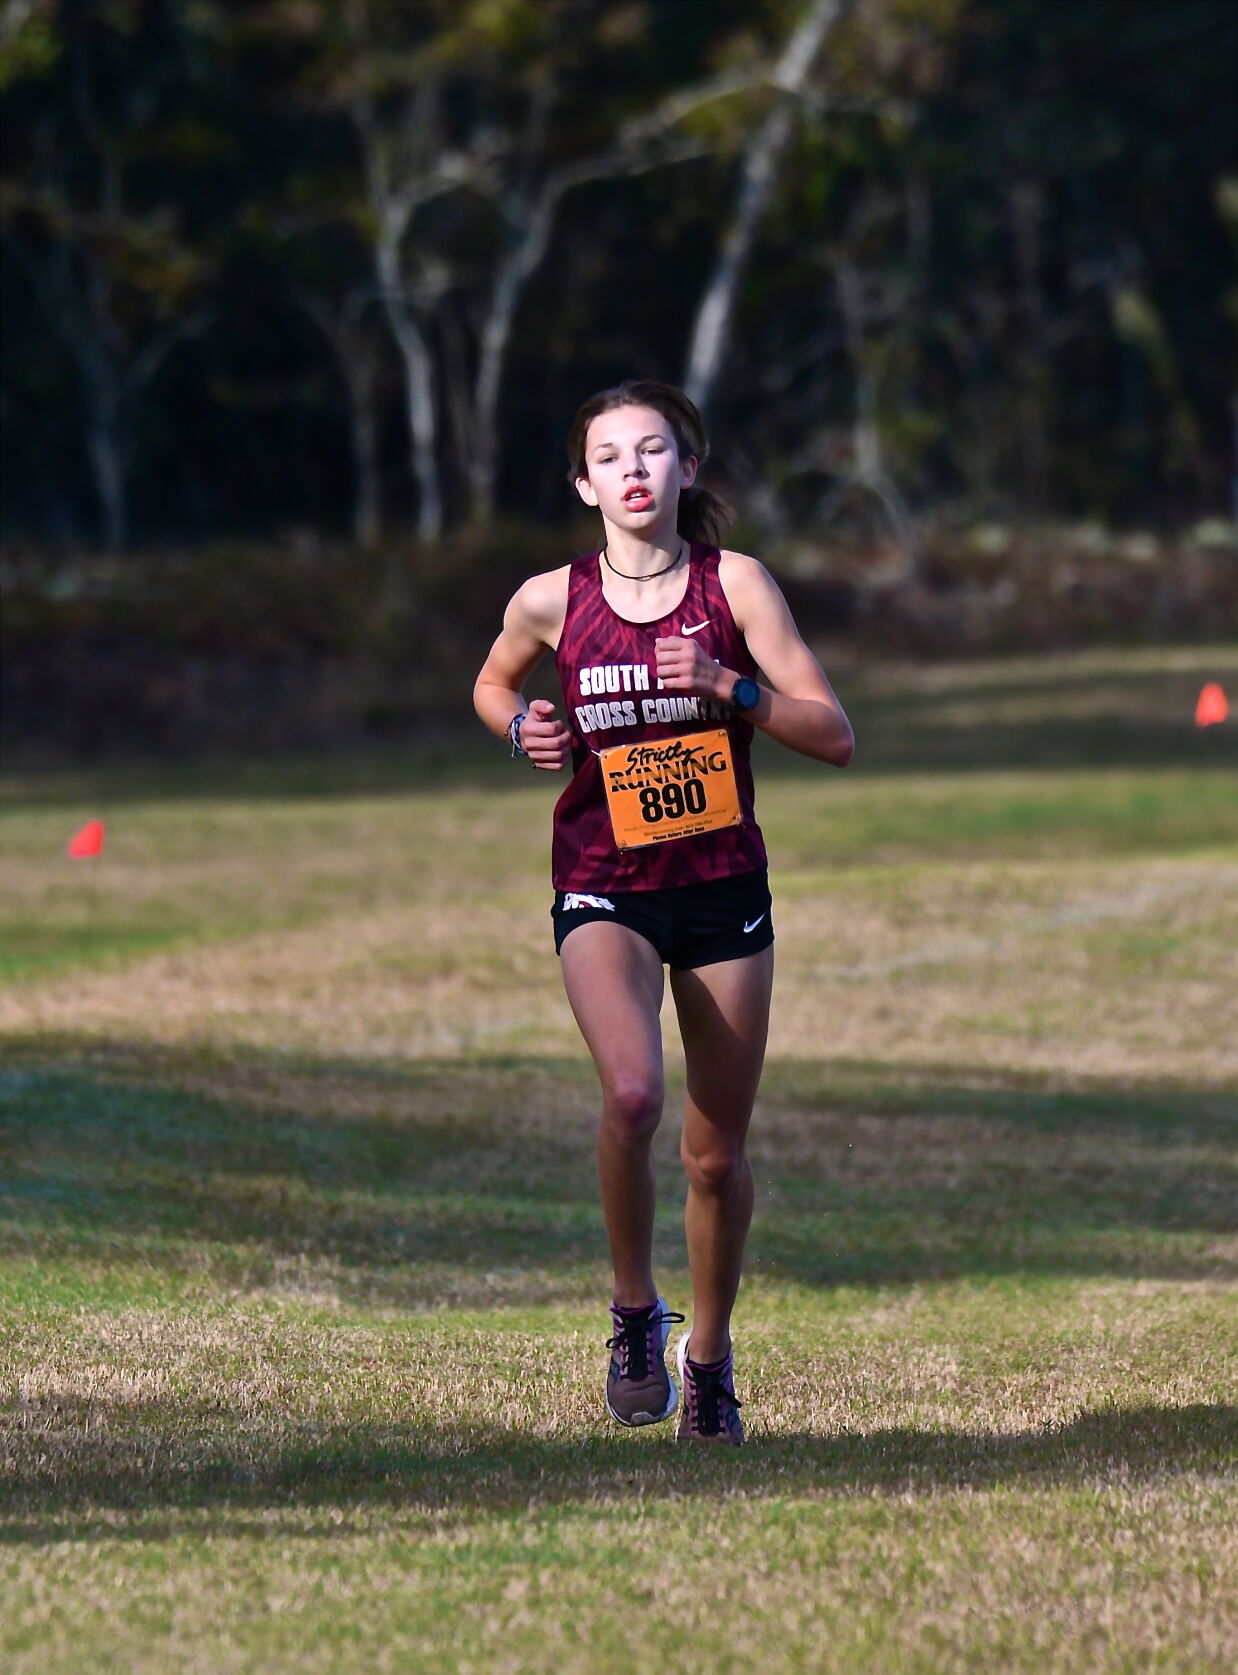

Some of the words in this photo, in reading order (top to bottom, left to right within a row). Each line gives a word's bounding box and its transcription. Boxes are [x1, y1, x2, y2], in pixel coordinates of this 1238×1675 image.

[579, 664, 649, 696] SOUTH
[575, 700, 637, 734] CROSS
[609, 751, 727, 792] RUNNING
[626, 741, 704, 775] Strictly
[639, 778, 706, 823] 890
